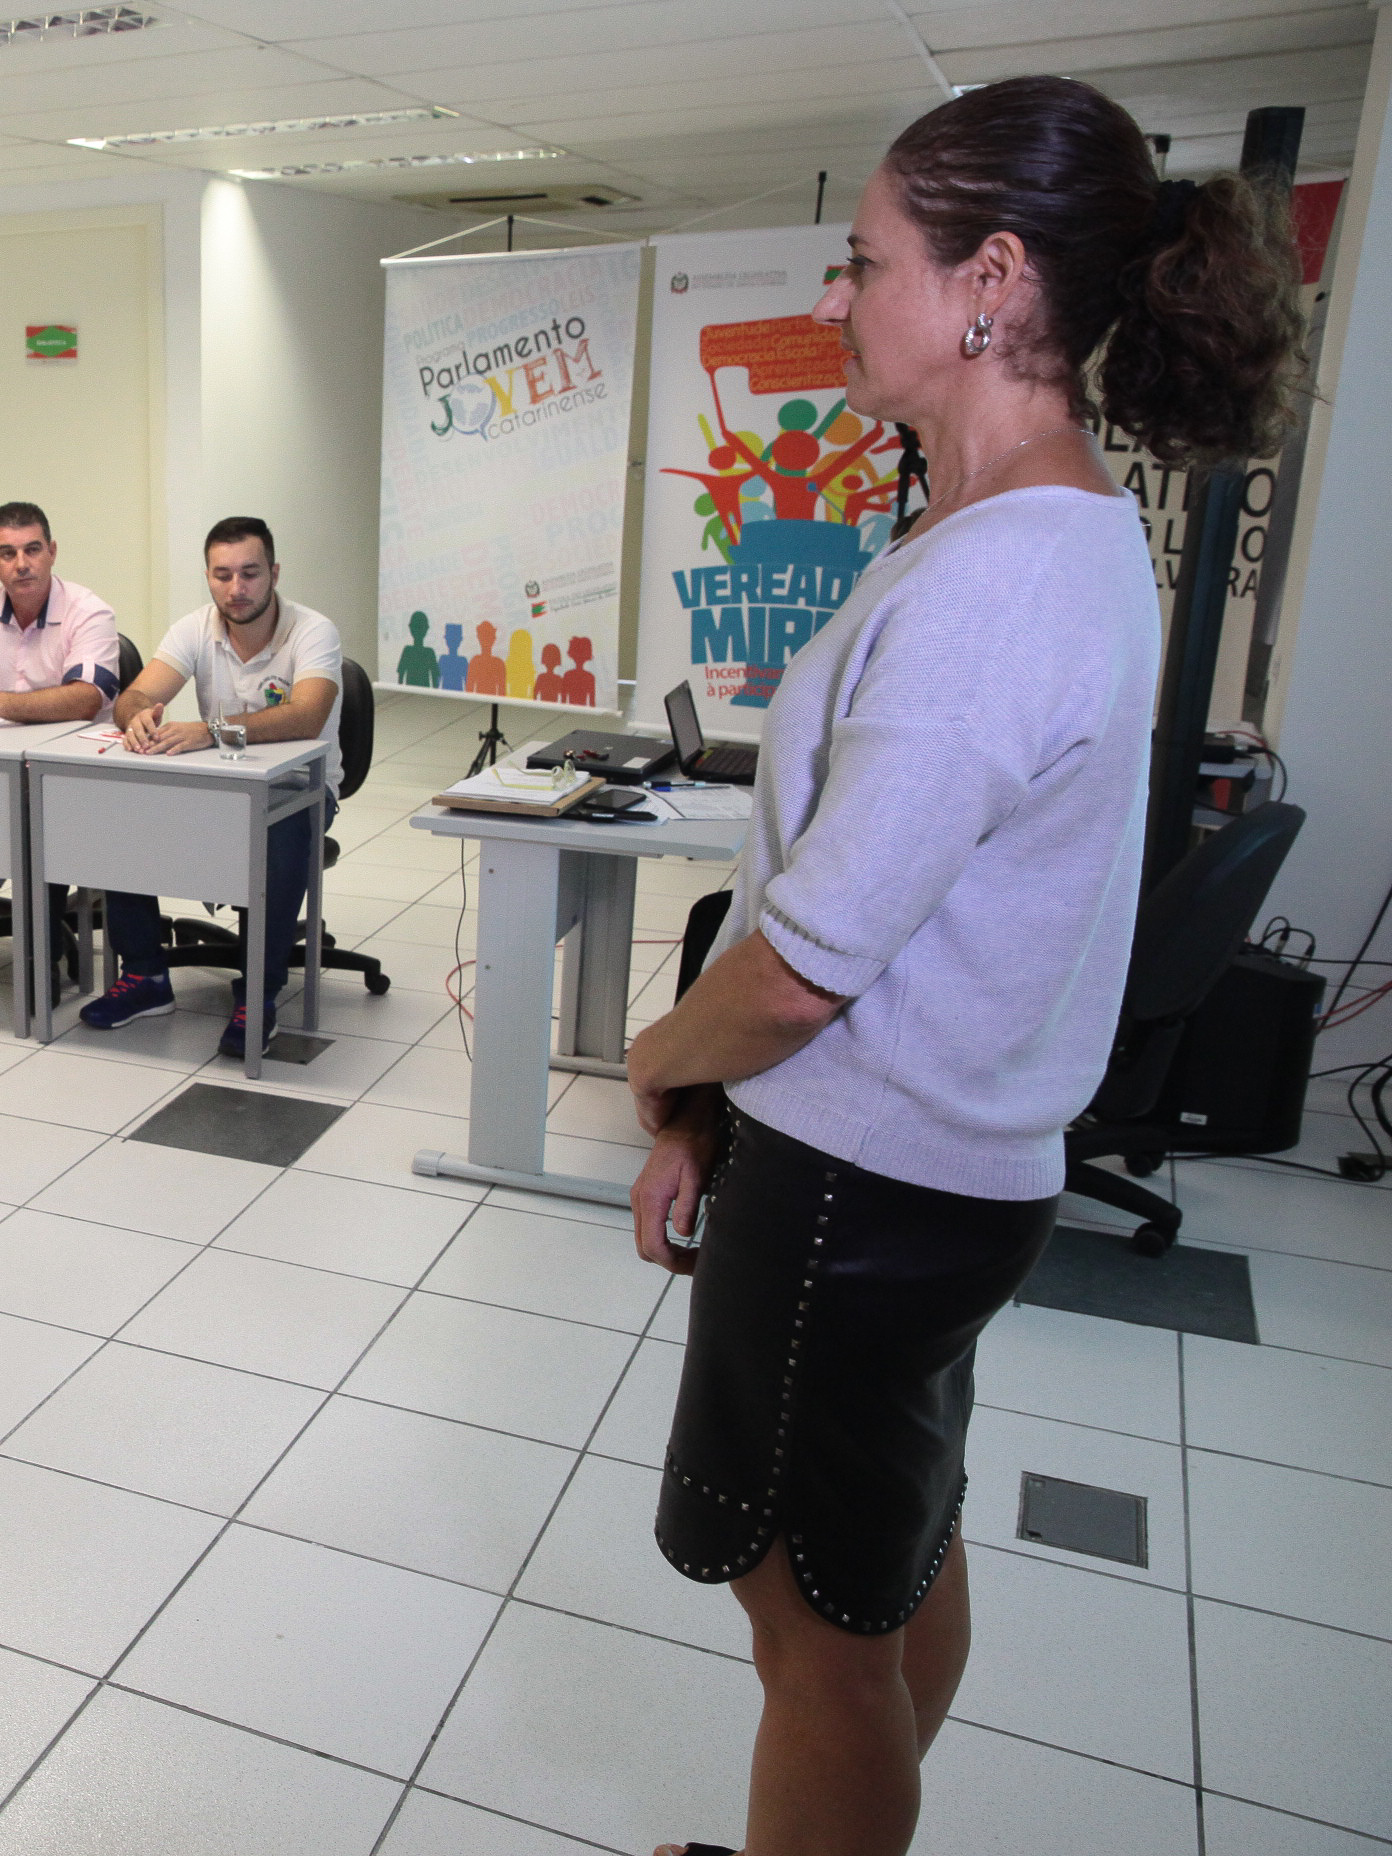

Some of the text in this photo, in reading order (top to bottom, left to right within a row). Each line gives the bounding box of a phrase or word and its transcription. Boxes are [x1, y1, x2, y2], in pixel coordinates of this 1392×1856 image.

[419, 316, 585, 397] Parlamento
[431, 338, 603, 440] JOVEM
[487, 381, 609, 441] catarinense
[672, 565, 862, 610] VEREAD
